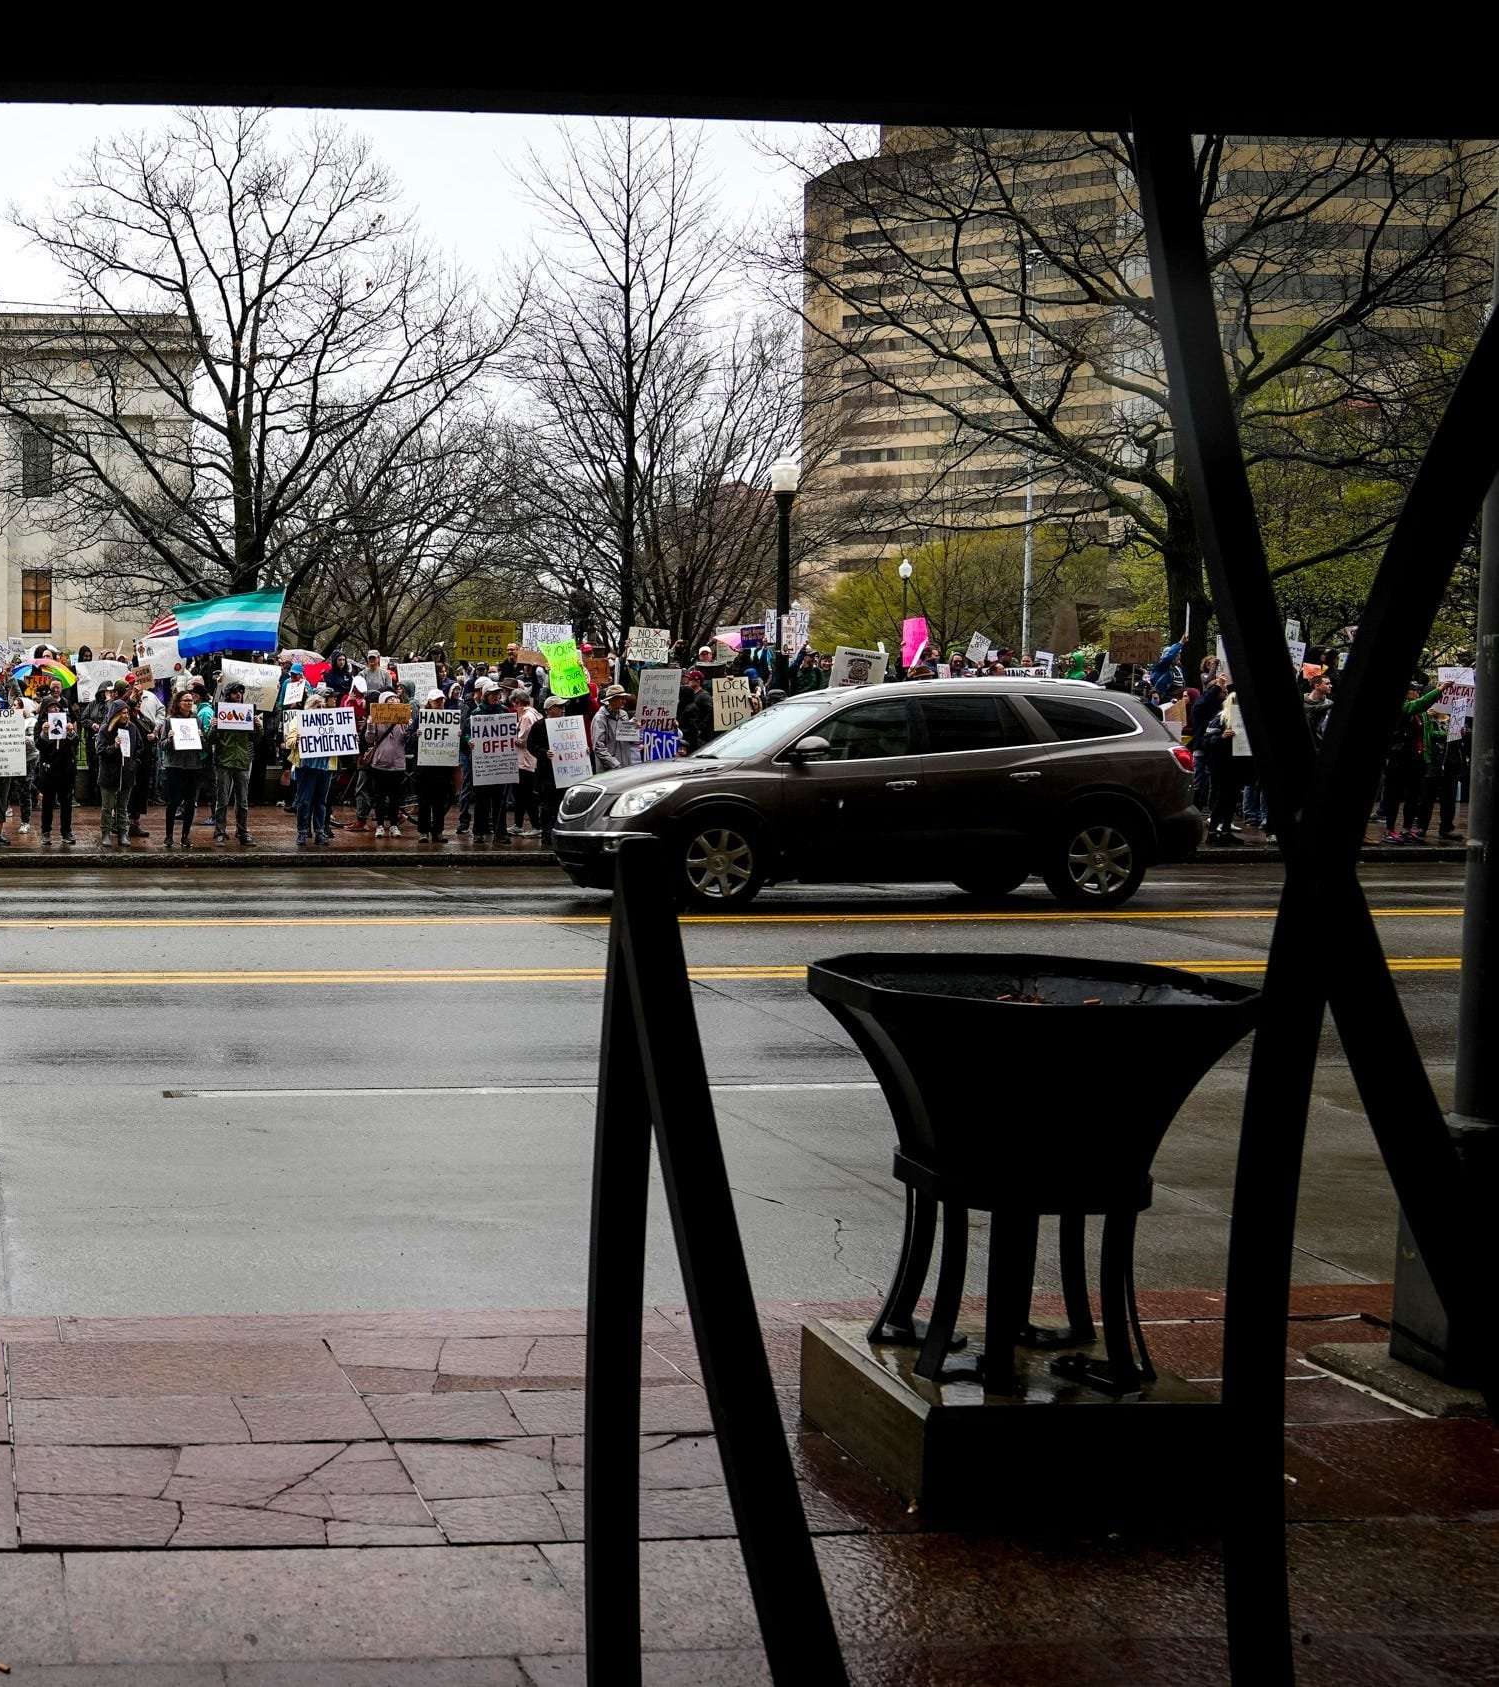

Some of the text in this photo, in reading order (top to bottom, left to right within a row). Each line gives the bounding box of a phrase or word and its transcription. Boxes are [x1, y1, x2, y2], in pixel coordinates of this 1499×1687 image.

[466, 624, 506, 633] ORANGE
[638, 629, 649, 638] NO
[470, 635, 501, 645] LIES
[628, 638, 659, 648] KINGS
[461, 647, 506, 657] MATTER
[716, 680, 748, 692] LOCK
[1450, 687, 1475, 697] DICTAT
[721, 695, 747, 708] HIM
[642, 706, 670, 716] For The
[302, 711, 354, 727] HANDS OFF
[420, 711, 460, 724] HANDS
[721, 713, 743, 726] UP
[318, 726, 336, 735] OUR
[424, 728, 449, 740] OFF
[472, 723, 517, 738] HANDS
[301, 734, 358, 754] DEMOCRACY
[483, 738, 514, 753] OFF!
[644, 732, 678, 761] RESIST
